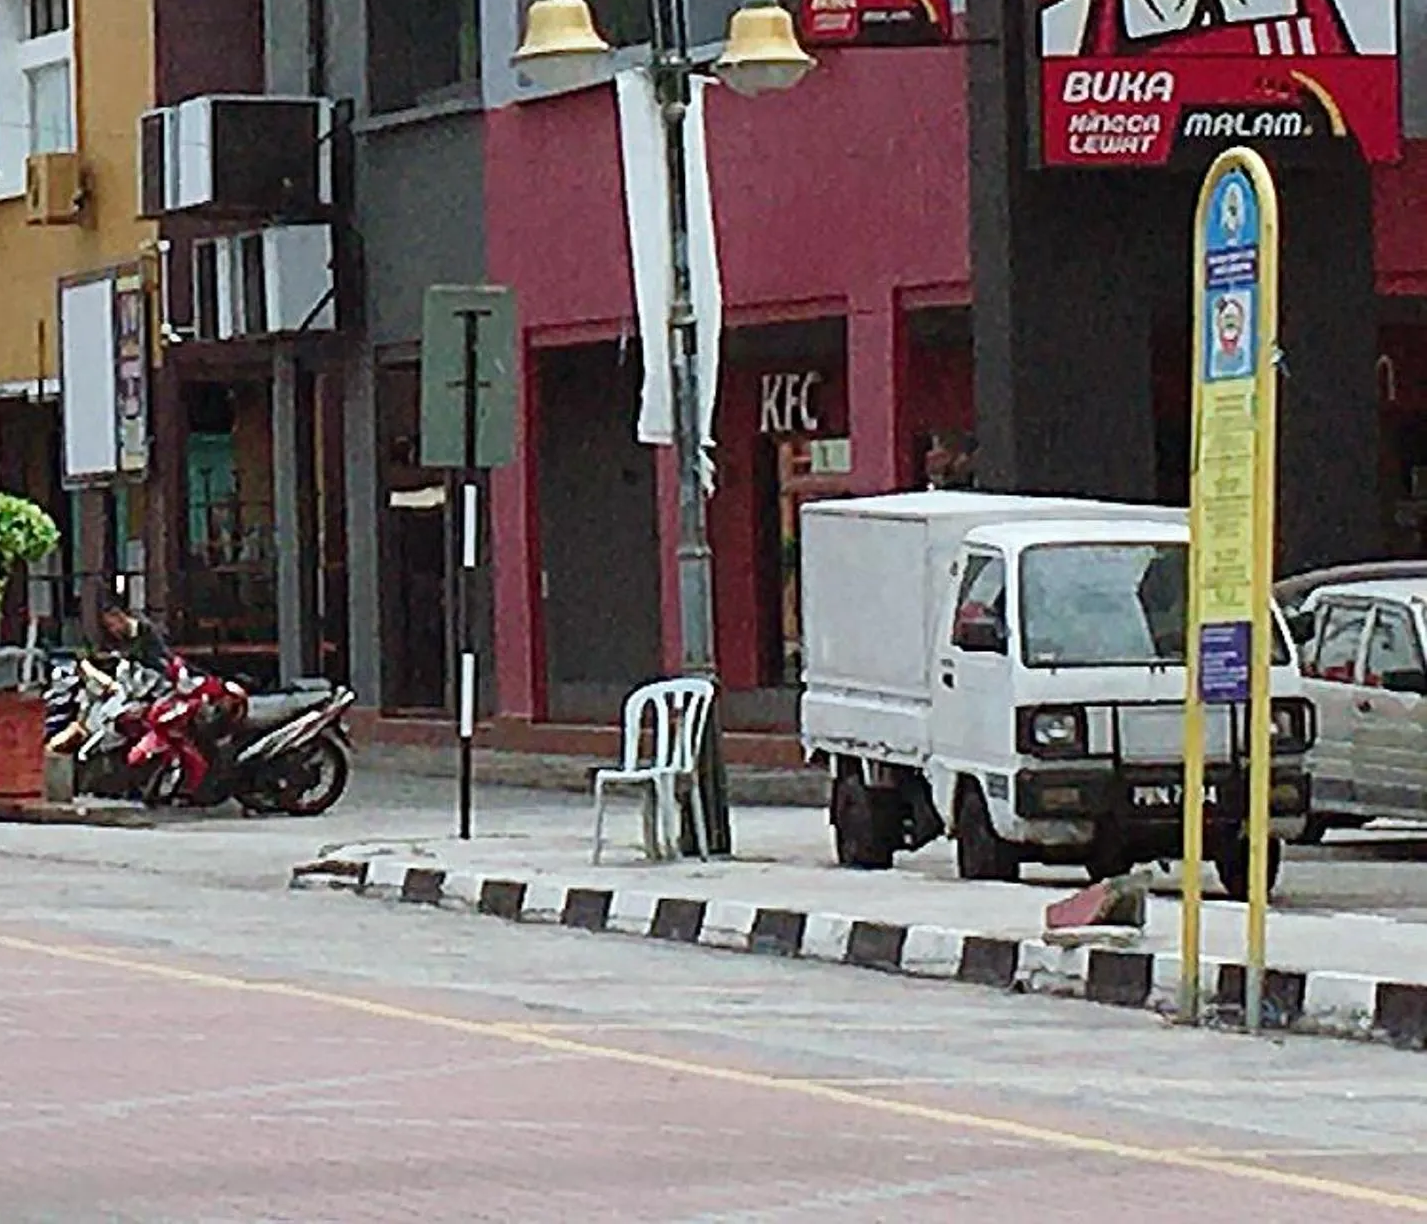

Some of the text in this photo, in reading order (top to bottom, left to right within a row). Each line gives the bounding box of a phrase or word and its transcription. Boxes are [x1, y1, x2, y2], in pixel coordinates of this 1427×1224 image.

[1062, 70, 1174, 103] BUKA
[1069, 133, 1158, 155] LEWAT
[760, 371, 821, 433] KFC
